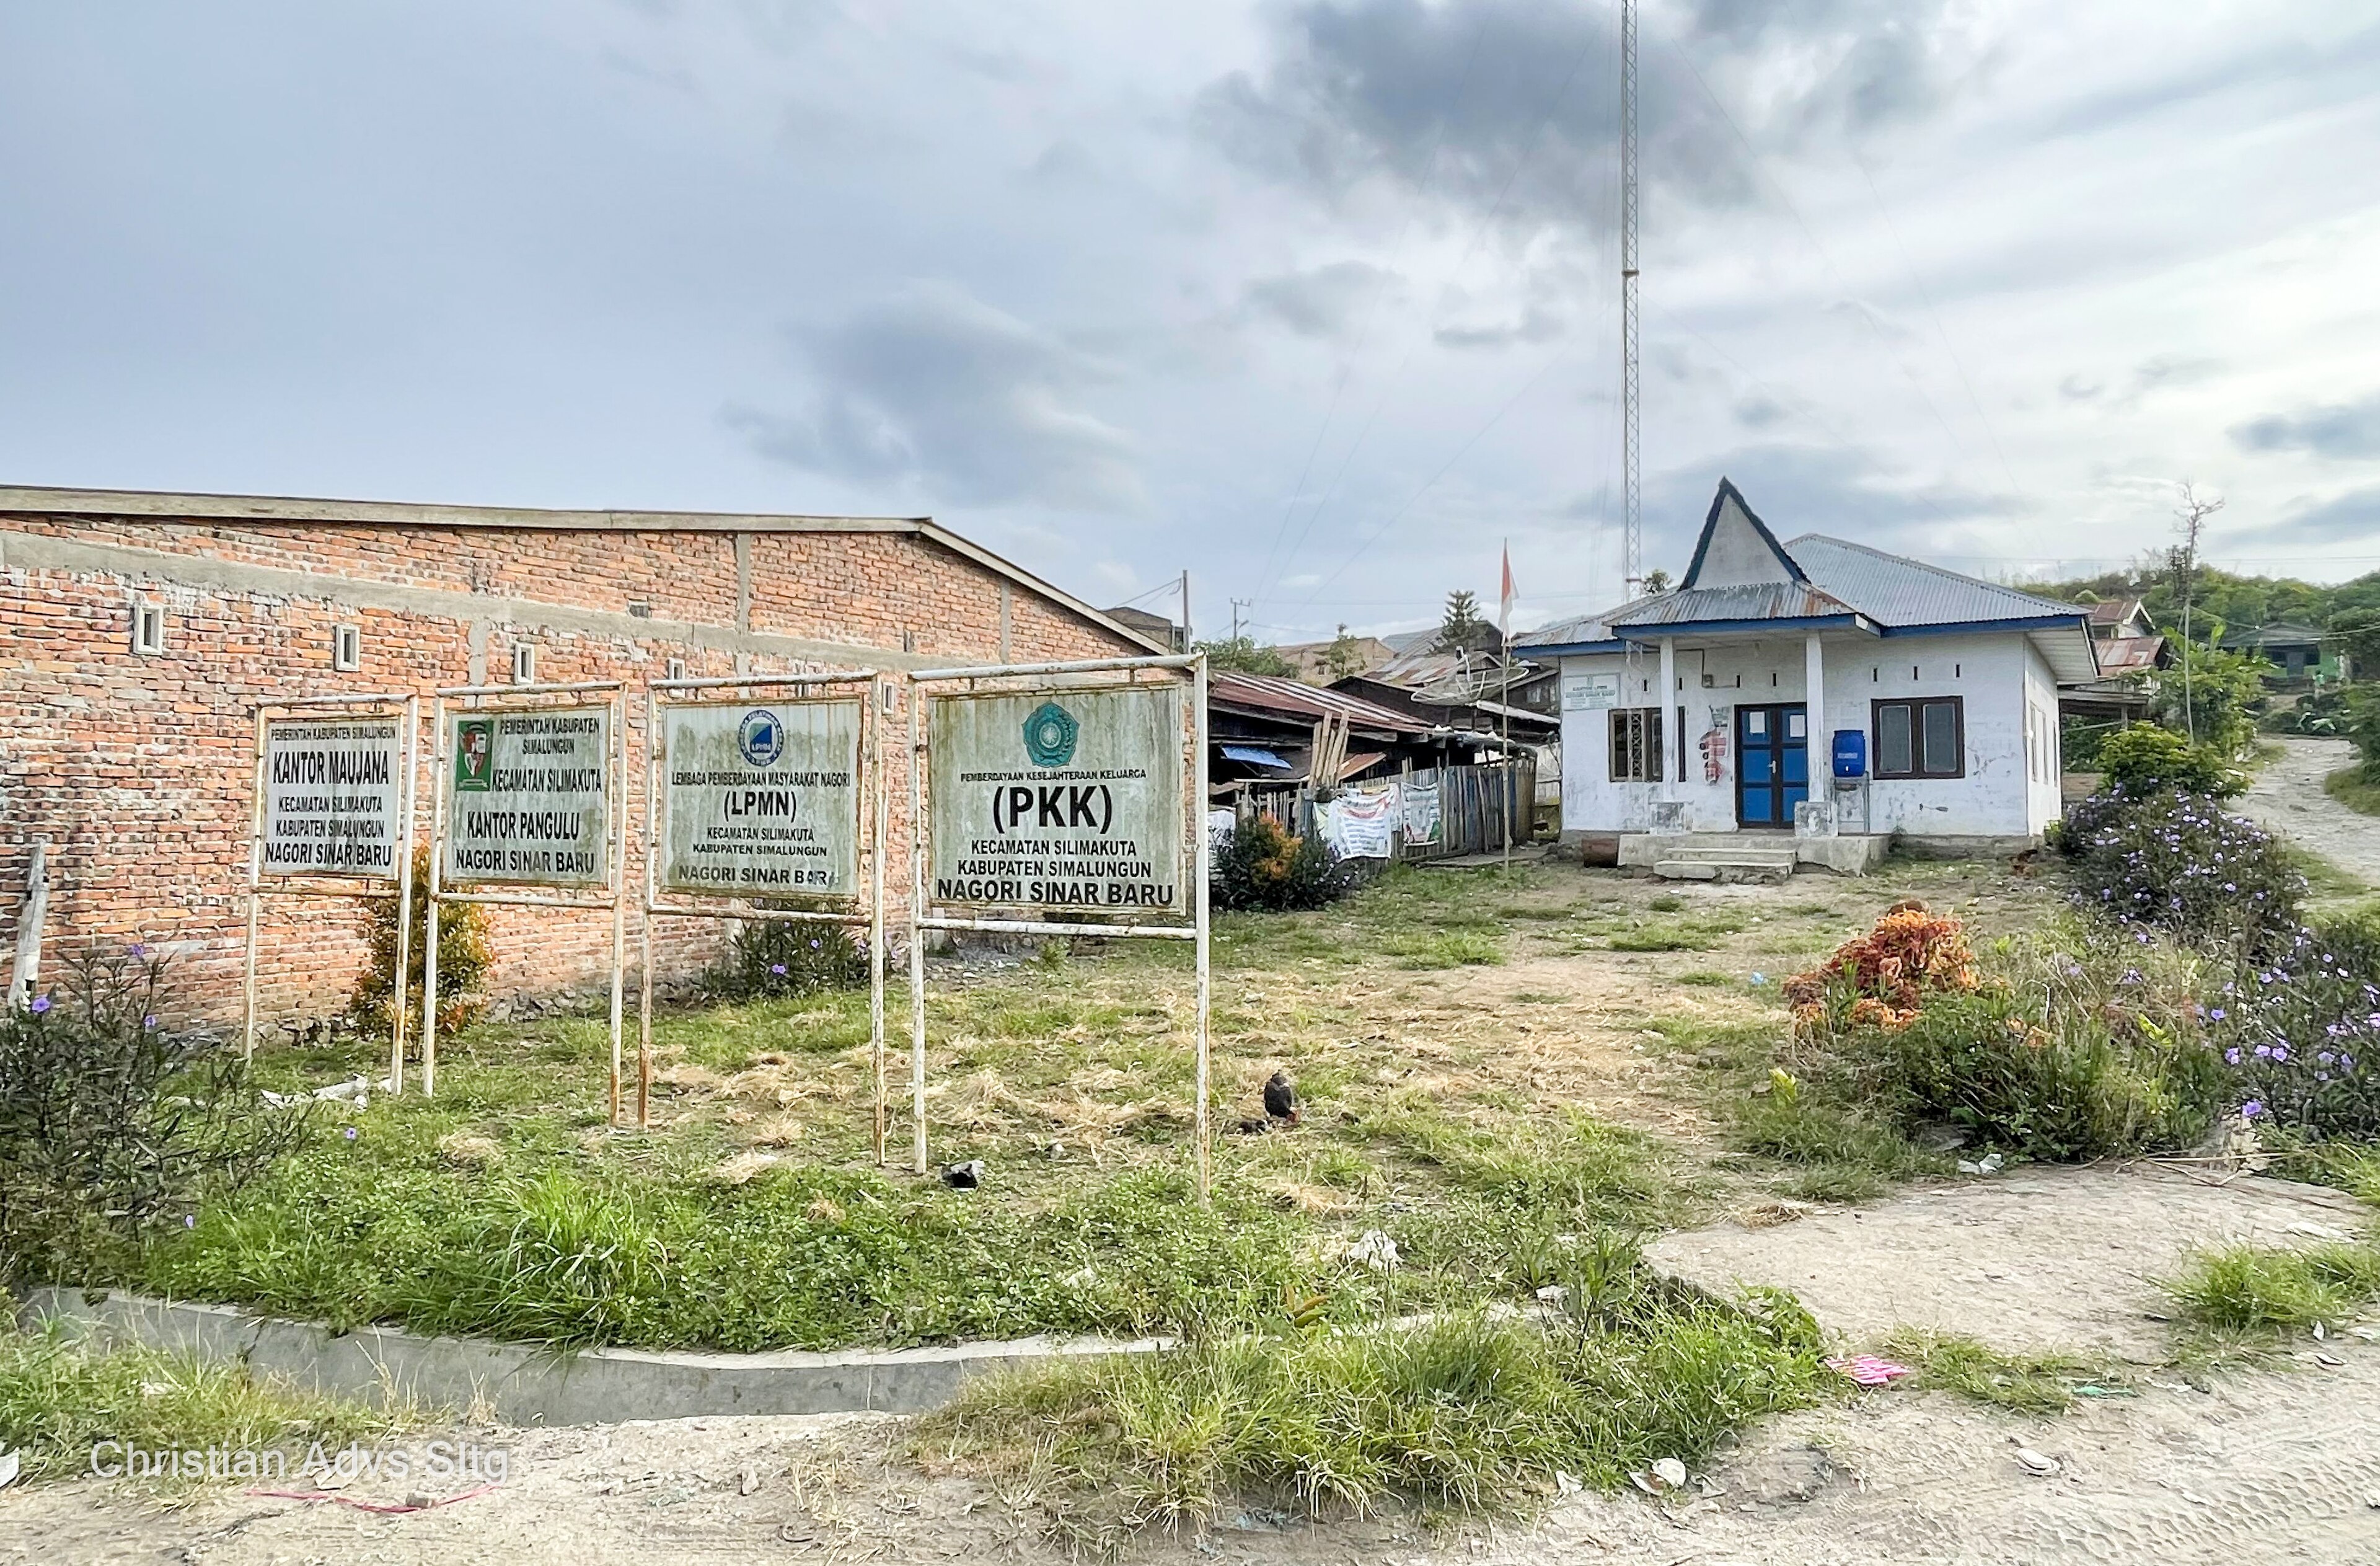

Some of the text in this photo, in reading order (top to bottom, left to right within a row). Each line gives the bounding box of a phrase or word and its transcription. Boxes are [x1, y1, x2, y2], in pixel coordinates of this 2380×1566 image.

[313, 727, 351, 740] KABUPATEN
[353, 727, 395, 739] SIMALUNGUN
[500, 718, 599, 735] PEMERINTAH KABUPATEN
[522, 738, 574, 754] SIMALUNGUN
[273, 751, 389, 785] KANTOR MAUJANA
[961, 769, 1146, 782] PEMBERDAYAAN KESEJAHTERAAN KELUARGA
[492, 769, 602, 792] KECAMATAN SILIMAKUTA
[672, 772, 850, 787] LEMBAGA PEMBERDAYAAN MASYARAKAT NAGORI
[279, 796, 382, 812] KECAMATAN SILIMAKUTA
[724, 790, 797, 822] (LPMN)
[993, 785, 1113, 834] (PKK)
[276, 820, 384, 838] KABUPATEN SIMALUNGUN
[467, 812, 579, 839] KANTOR PANGULU
[707, 827, 814, 841] KECAMATAN SILIMAKUTA
[265, 843, 392, 867] NAGORI SINAR BARU
[693, 844, 827, 856] KABUPATEN SIMALUNGUN
[972, 840, 1137, 856] KECAMATAN SILIMAKUTA
[456, 849, 594, 874] NAGORI SINAR BARU
[958, 860, 1152, 877] KABUPATEN SIMALUNGUN
[679, 865, 736, 881] NAGORI
[741, 868, 790, 883] SINAR
[938, 879, 1173, 906] NAGORI SINAR BARU
